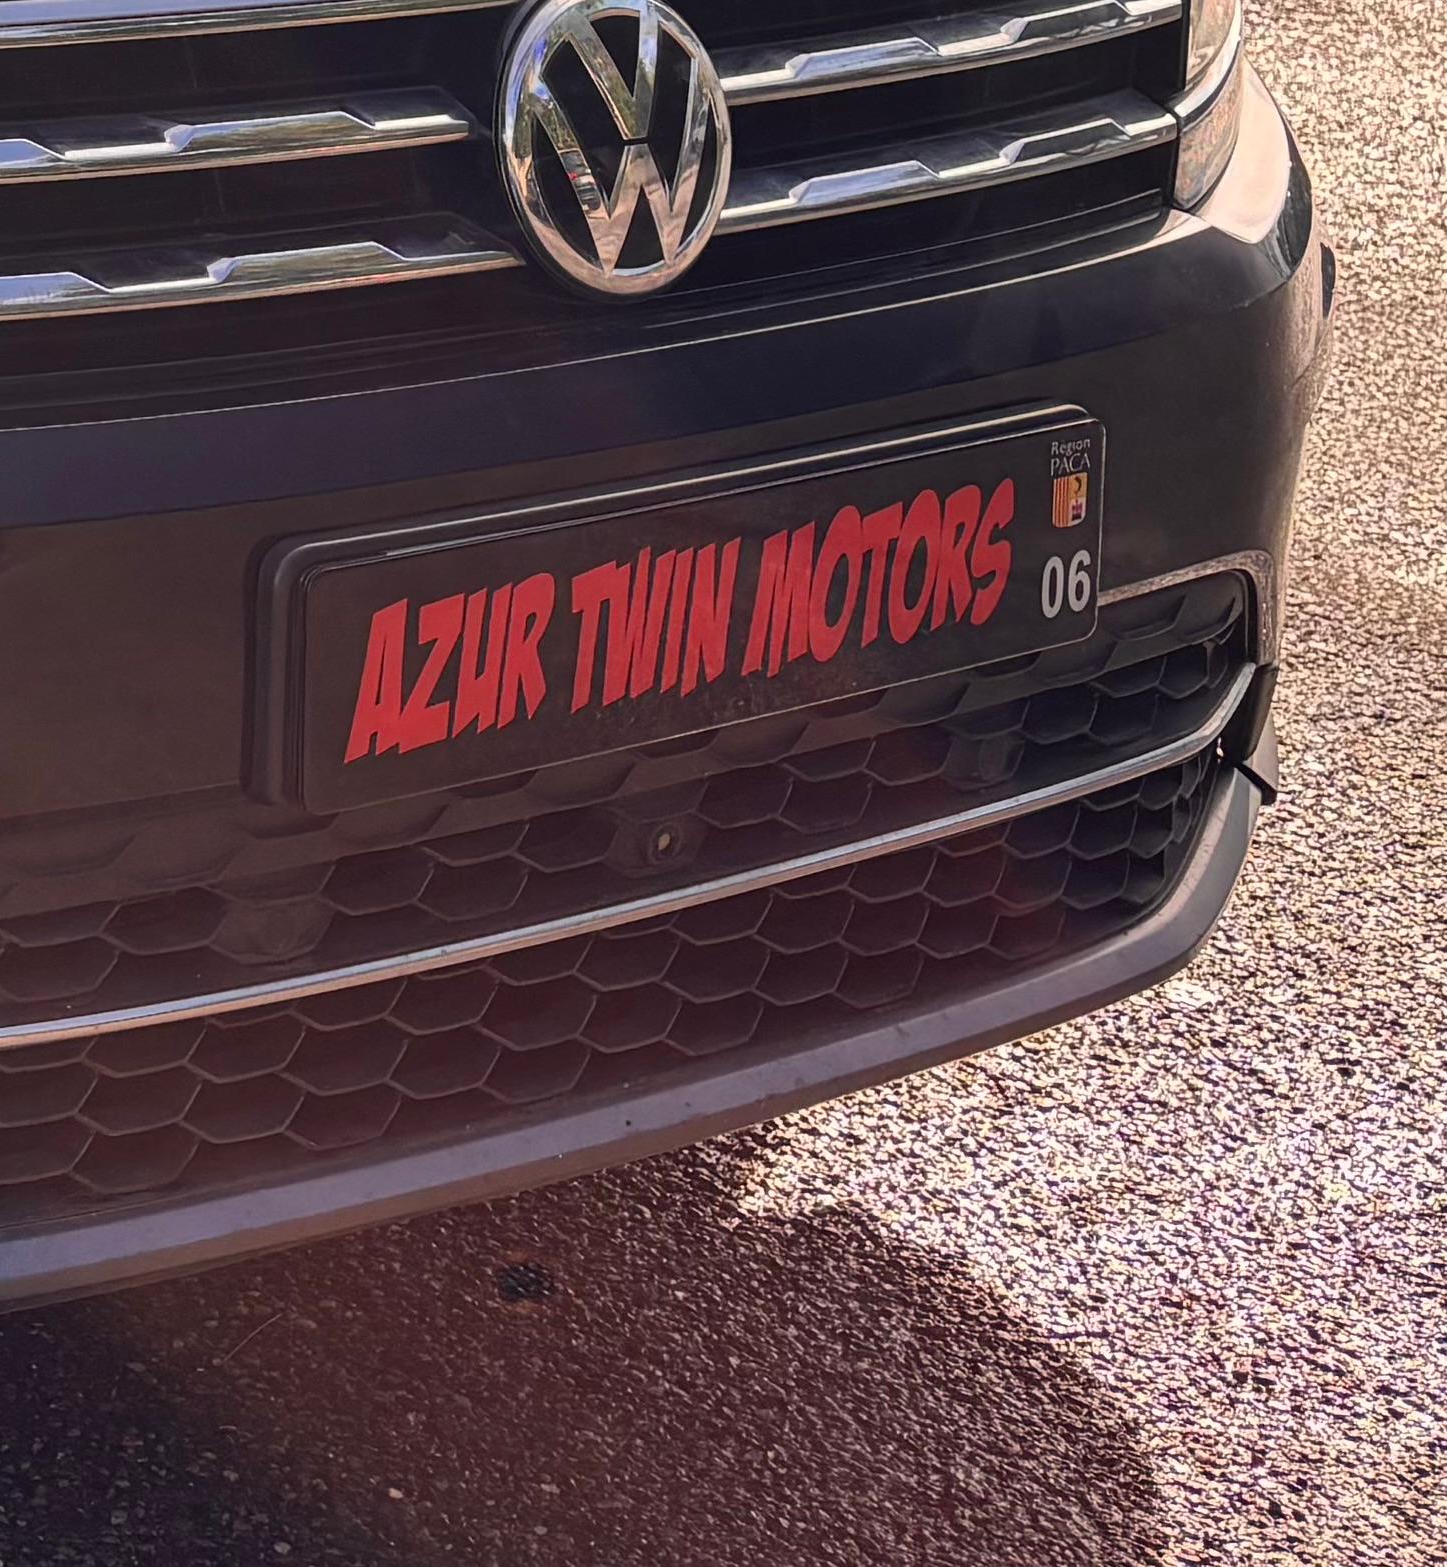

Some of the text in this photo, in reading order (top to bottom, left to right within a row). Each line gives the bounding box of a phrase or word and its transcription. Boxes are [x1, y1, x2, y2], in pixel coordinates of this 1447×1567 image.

[1050, 453, 1091, 476] PACA
[1041, 549, 1092, 619] 06
[344, 478, 1014, 764] AZUR TWIN MOTORS
